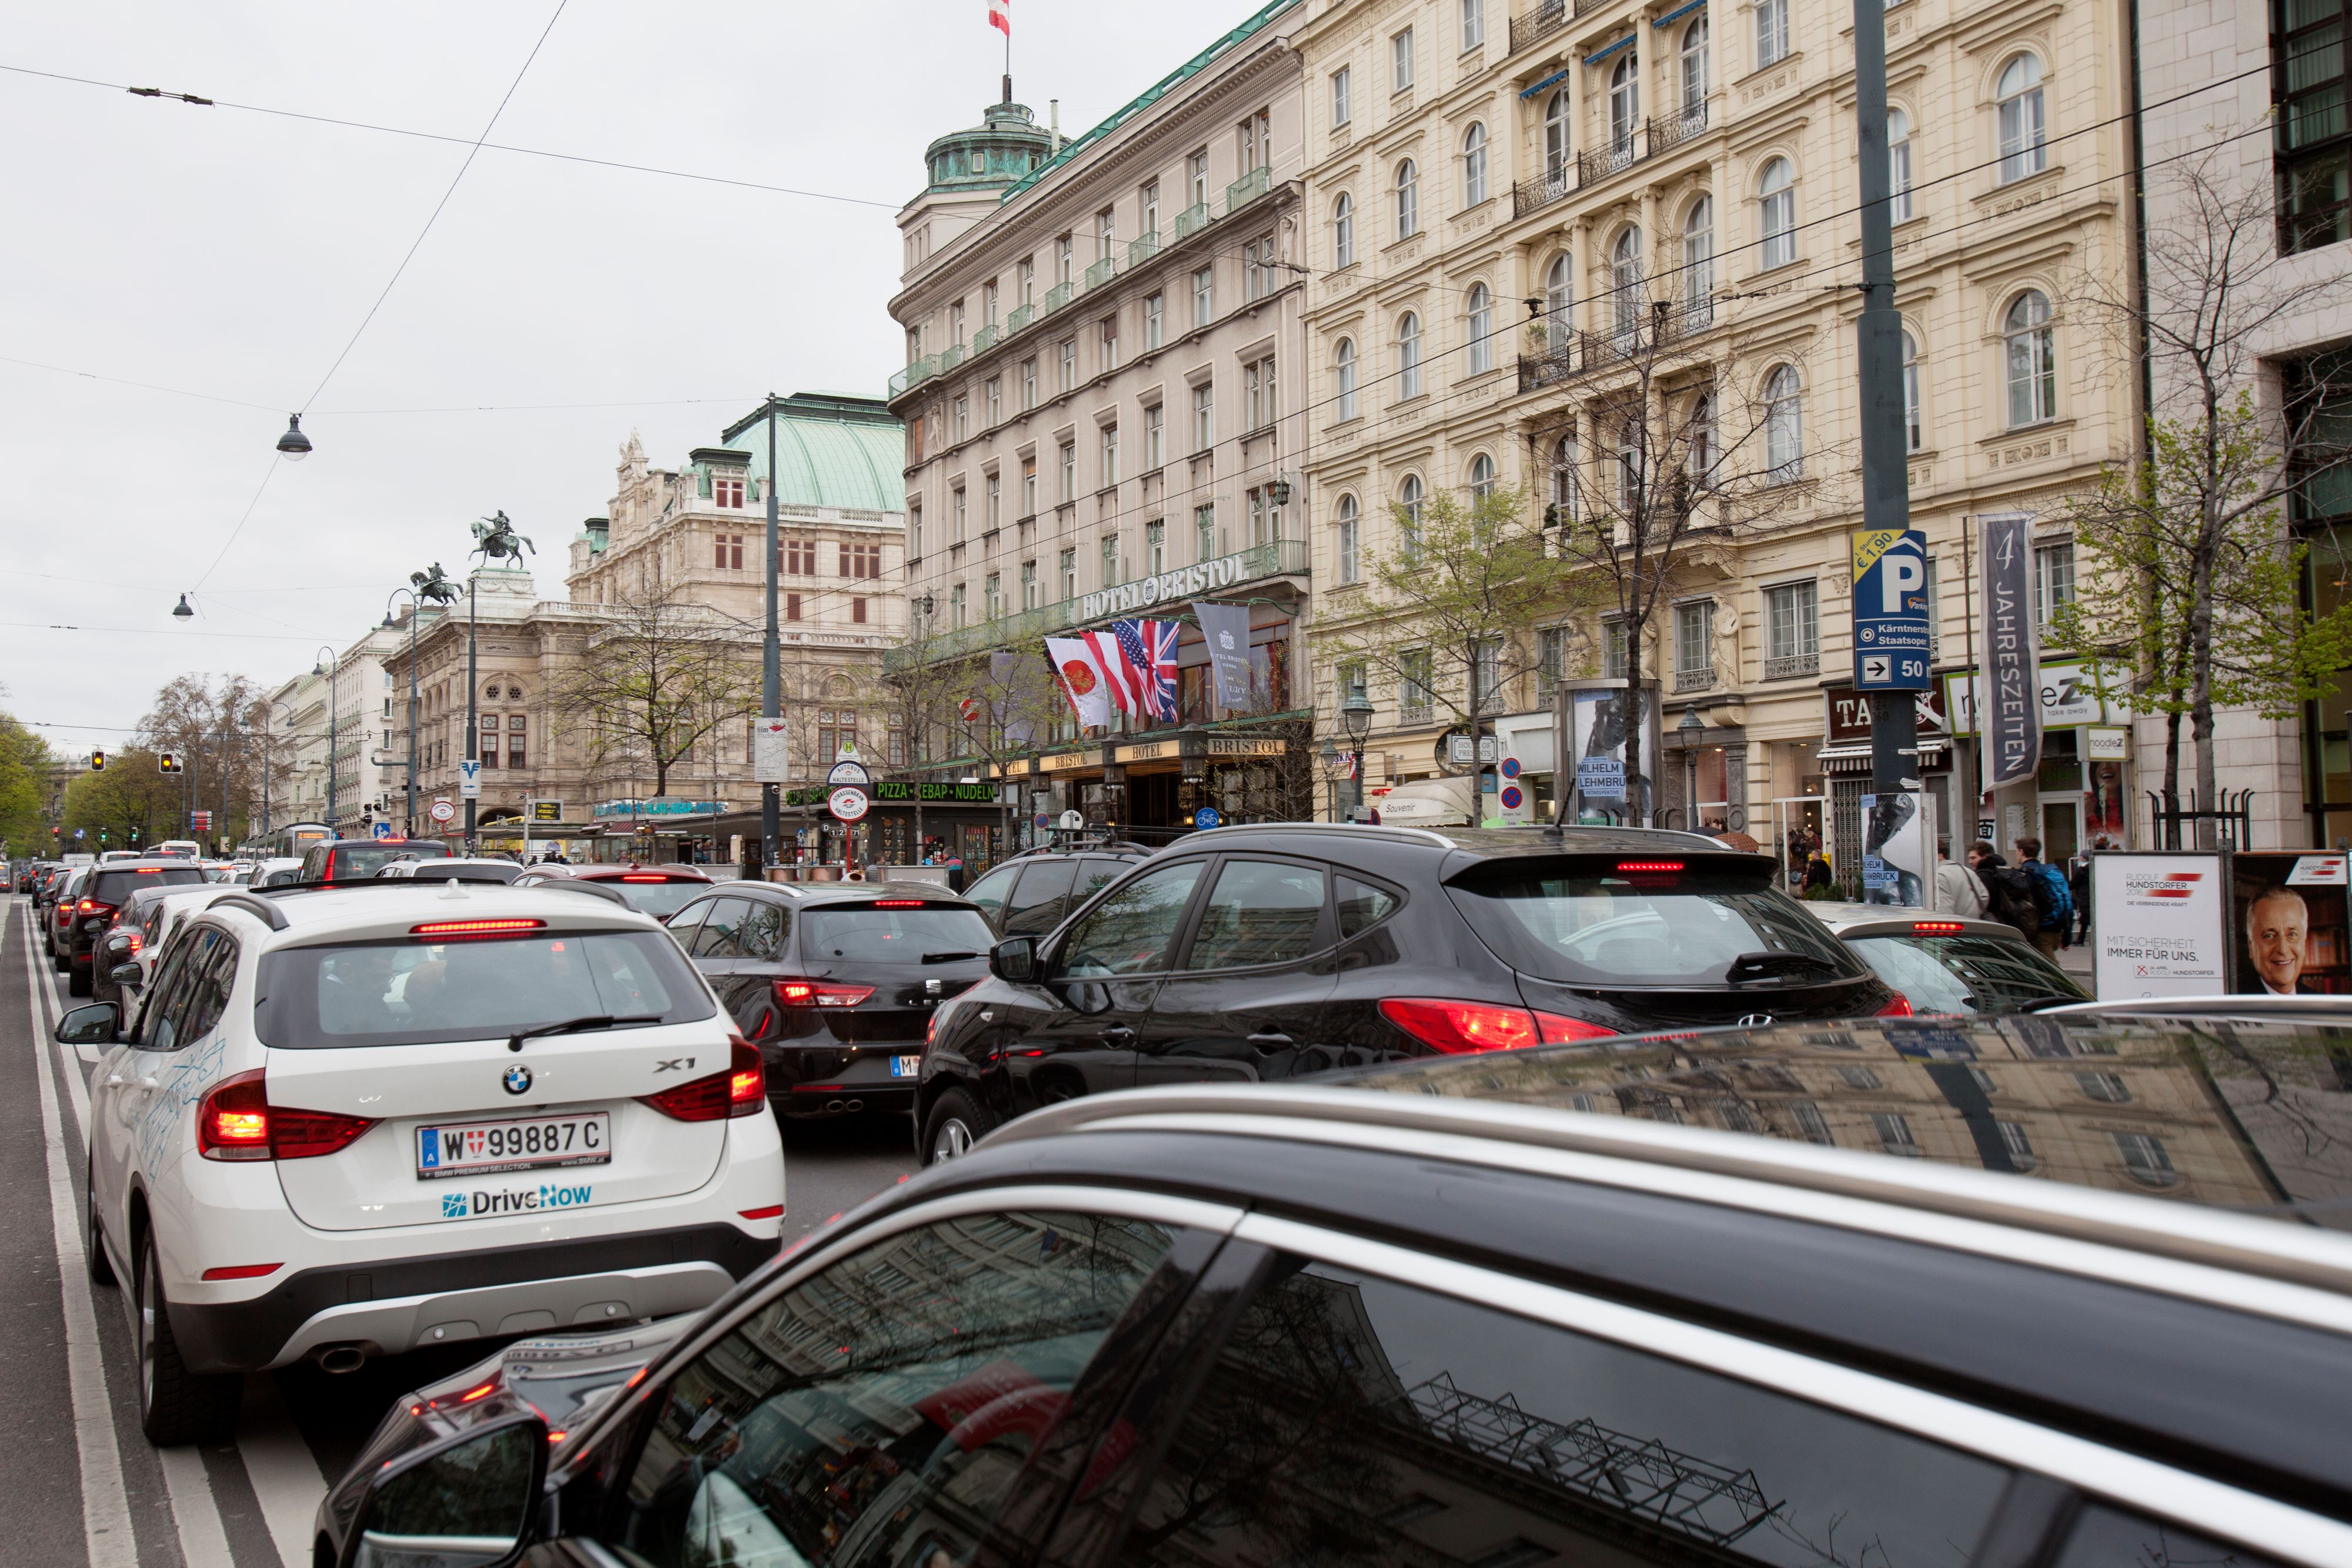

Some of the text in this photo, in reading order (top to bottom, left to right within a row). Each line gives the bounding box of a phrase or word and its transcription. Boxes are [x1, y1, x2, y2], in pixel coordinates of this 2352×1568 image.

[1859, 532, 1879, 551] Stunde
[1857, 532, 1892, 568] € 1,90
[1082, 554, 1250, 620] HOTEL BRISTOL
[1882, 554, 1923, 612] P
[1878, 636, 1927, 647] Staatsoper
[1901, 660, 1923, 677] 50
[1996, 582, 2025, 771] JAHRESZEITEN
[2067, 707, 2088, 716] away
[846, 743, 852, 751] H
[1132, 744, 1162, 759] HOTEL
[1212, 740, 1282, 754] BRISTOL
[1055, 753, 1087, 768] BRISTOL
[837, 765, 860, 774] AUTOBUS
[1577, 764, 1619, 773] WILHELM
[1580, 777, 1625, 787] LEHMBRU
[833, 790, 864, 802] STRASSENBAHN
[878, 783, 907, 798] PIZZA
[956, 784, 994, 800] NUDELN
[834, 807, 864, 817] HALTESTELLE
[1385, 803, 1415, 813] Souvenir
[2107, 935, 2197, 949] MIT SICHERHEIT.
[2107, 948, 2199, 962] IMMER FÜR UNS.
[652, 1057, 696, 1074] X1
[901, 1058, 911, 1074] M
[444, 1121, 599, 1161] W 99887 C
[426, 1153, 435, 1163] A
[435, 1169, 454, 1178] BMW
[454, 1166, 489, 1176] PREMIUM
[561, 1156, 605, 1167] www.BMW.at
